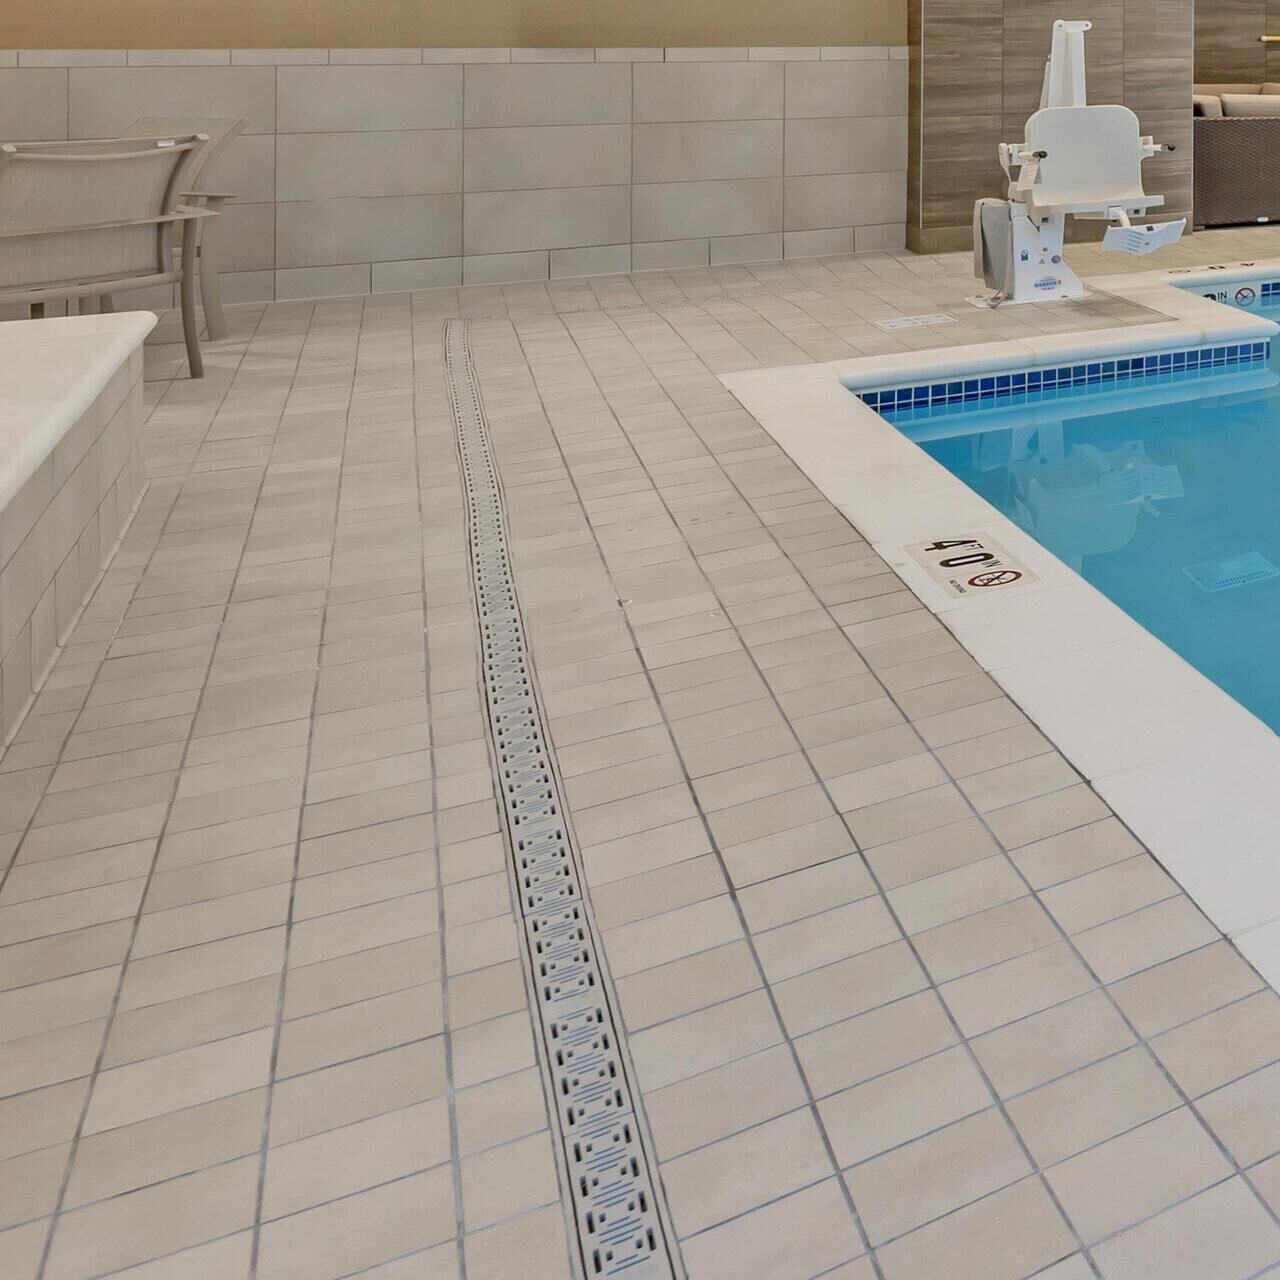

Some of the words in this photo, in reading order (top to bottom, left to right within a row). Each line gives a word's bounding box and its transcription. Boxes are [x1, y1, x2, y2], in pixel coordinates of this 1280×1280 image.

[1217, 291, 1228, 300] IN
[924, 539, 978, 552] 4
[939, 553, 994, 568] 0
